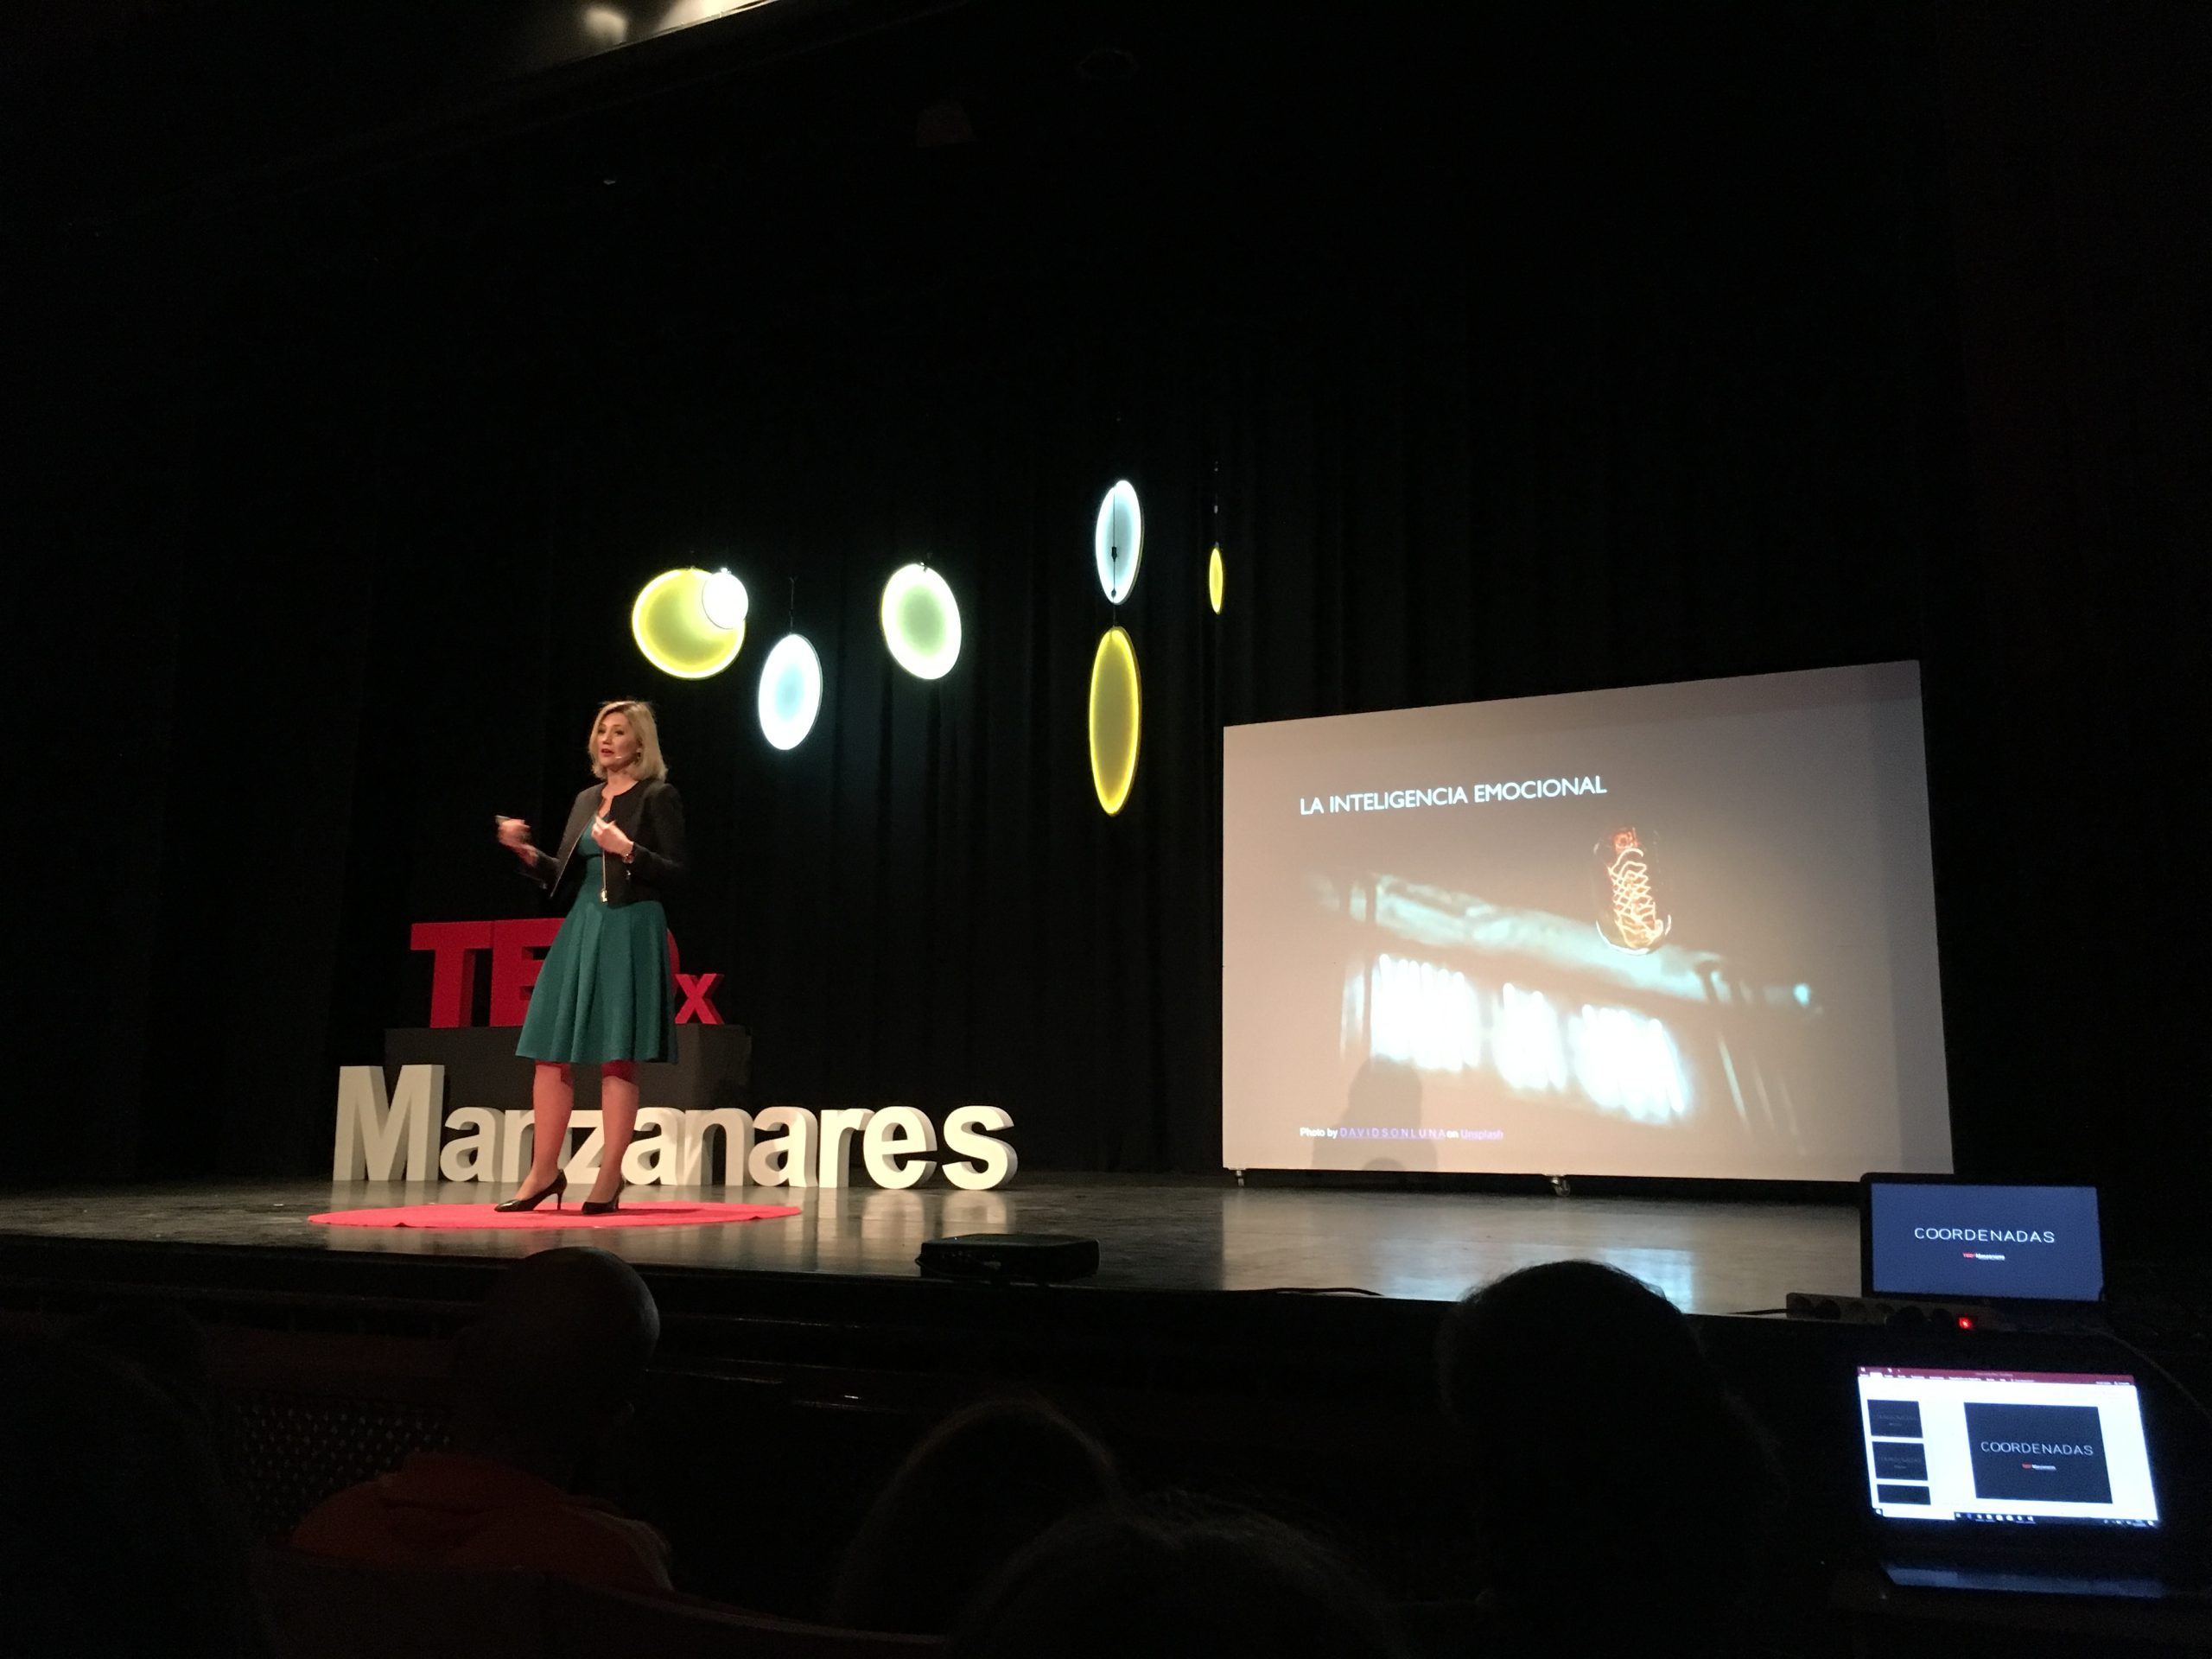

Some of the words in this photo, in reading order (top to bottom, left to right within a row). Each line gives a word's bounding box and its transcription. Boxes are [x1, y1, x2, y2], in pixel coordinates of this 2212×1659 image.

[1300, 797, 1325, 816] LA
[1330, 785, 1468, 813] INTELIGENCIA
[1474, 775, 1607, 804] EMOCIONAL
[1299, 1127, 1325, 1138] Photo
[1326, 1127, 1338, 1140] by
[1446, 1128, 1459, 1139] on
[1460, 1128, 1504, 1141] Unsplash
[1913, 1227, 2056, 1244] COORDENADAS
[1980, 1440, 2094, 1457] COORDENADAS
